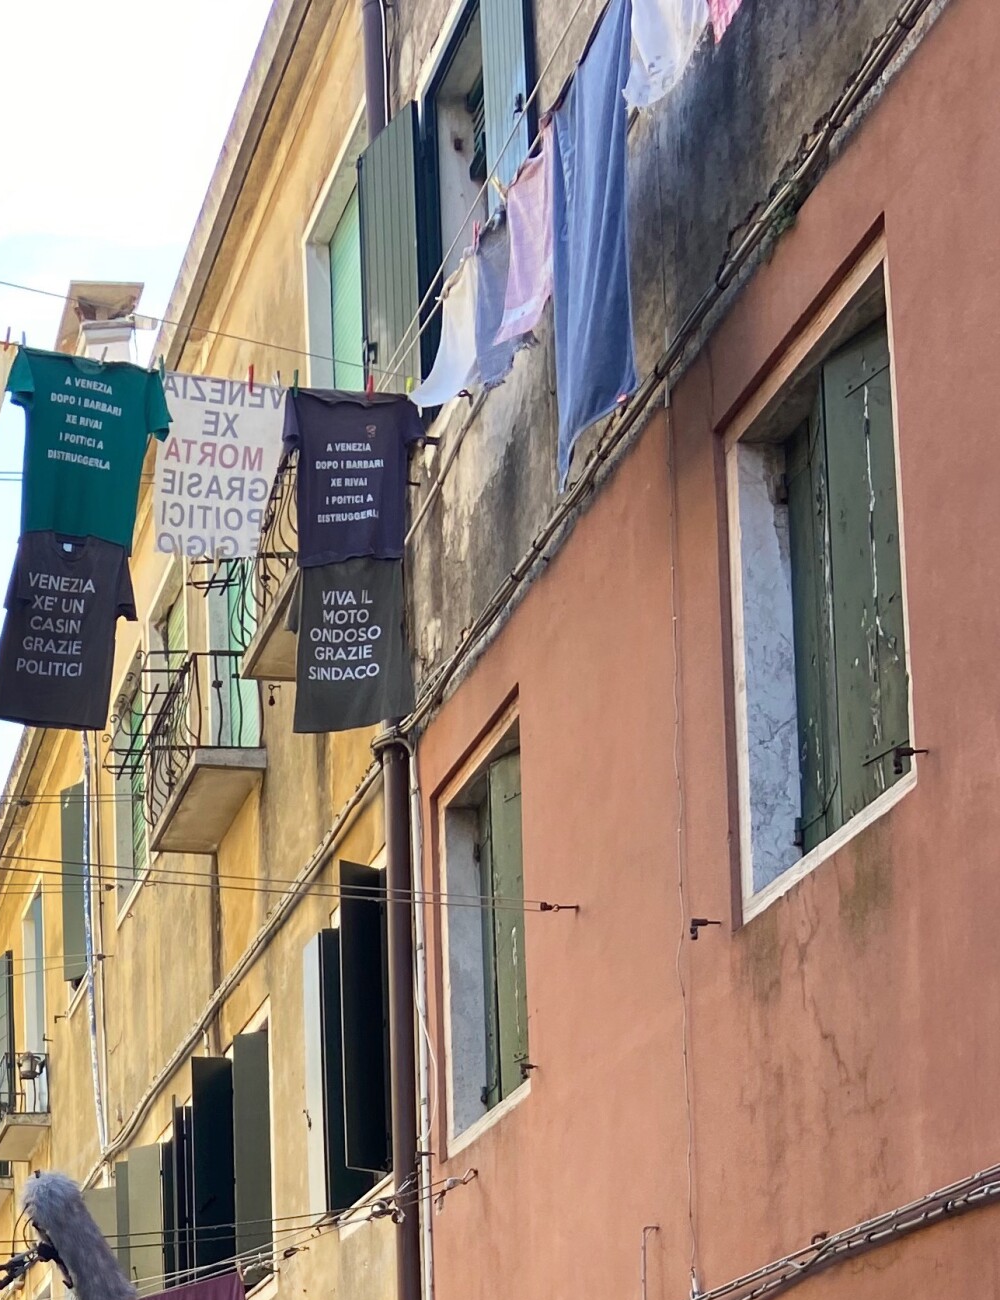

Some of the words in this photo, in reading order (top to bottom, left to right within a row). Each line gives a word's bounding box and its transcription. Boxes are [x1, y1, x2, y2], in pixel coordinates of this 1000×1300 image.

[64, 376, 72, 386] A
[74, 377, 113, 395] VENEZIA
[50, 392, 76, 405] DOPO
[83, 398, 122, 417] BARBARI
[65, 413, 77, 425] XE
[79, 414, 103, 430] RIVAI
[97, 440, 104, 450] A
[326, 443, 333, 452] A
[334, 442, 372, 452] VENEZIA
[47, 449, 111, 471] DISTRUGGERLA
[315, 460, 339, 470] DOPO
[345, 458, 384, 469] BARBARI
[330, 477, 343, 488] XE
[344, 477, 368, 487] RIVAI
[366, 493, 374, 502] A
[28, 571, 96, 594] VENEZIA
[322, 590, 357, 605] VIVA
[361, 589, 373, 604] IL
[62, 598, 85, 614] UN
[30, 615, 82, 634] CASIN
[322, 608, 370, 625] MOTO
[310, 625, 381, 643] ONDOSO
[22, 636, 83, 655] GRAZIE
[314, 644, 373, 661] GRAZIE
[16, 657, 83, 677] POLITICI
[308, 662, 380, 681] SINDACO
